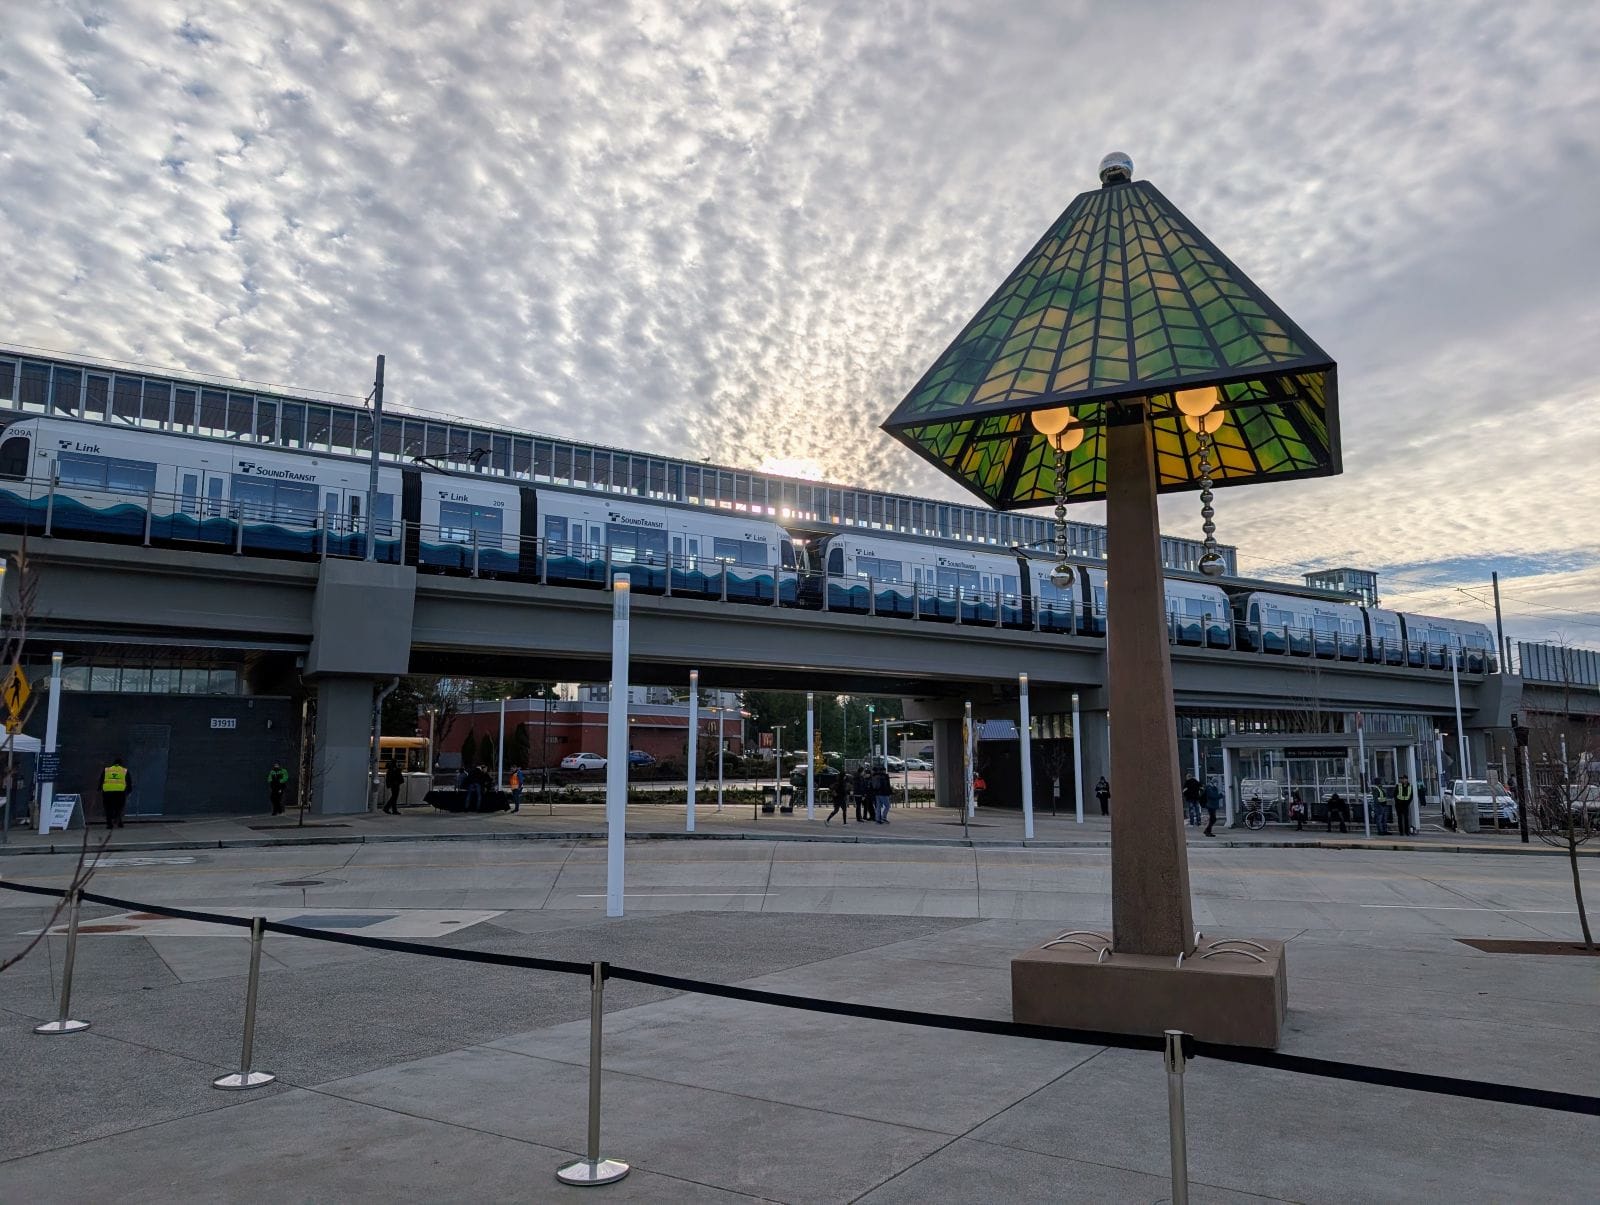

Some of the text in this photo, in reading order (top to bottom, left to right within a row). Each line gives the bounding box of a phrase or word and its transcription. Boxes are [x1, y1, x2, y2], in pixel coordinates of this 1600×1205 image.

[8, 428, 33, 438] 209A
[75, 442, 101, 454] Link
[451, 493, 469, 503] Link
[753, 534, 767, 542] Link
[864, 549, 875, 557] Link
